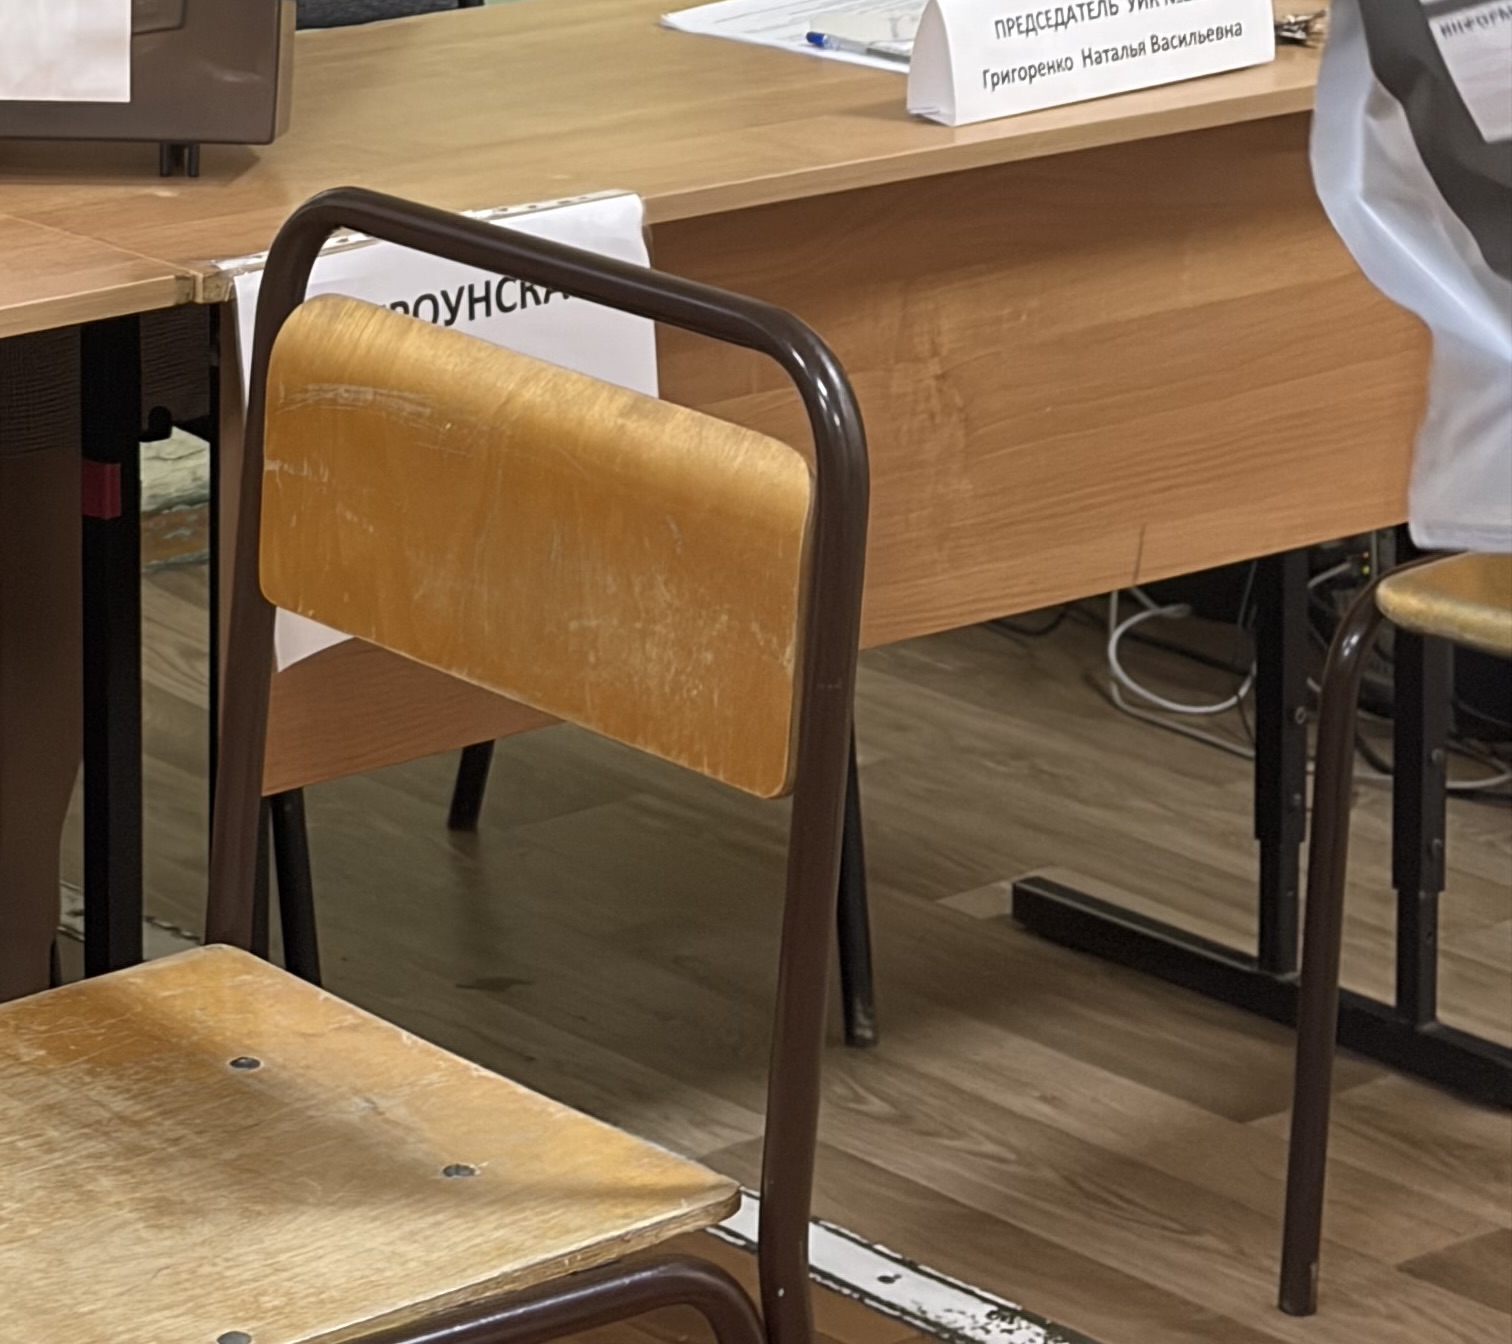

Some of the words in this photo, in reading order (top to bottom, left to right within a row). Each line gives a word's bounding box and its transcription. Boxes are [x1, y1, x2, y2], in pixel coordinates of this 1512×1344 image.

[982, 54, 1074, 92] Григоренко
[1080, 39, 1147, 68] Наталья
[1149, 21, 1243, 54] Васильевна
